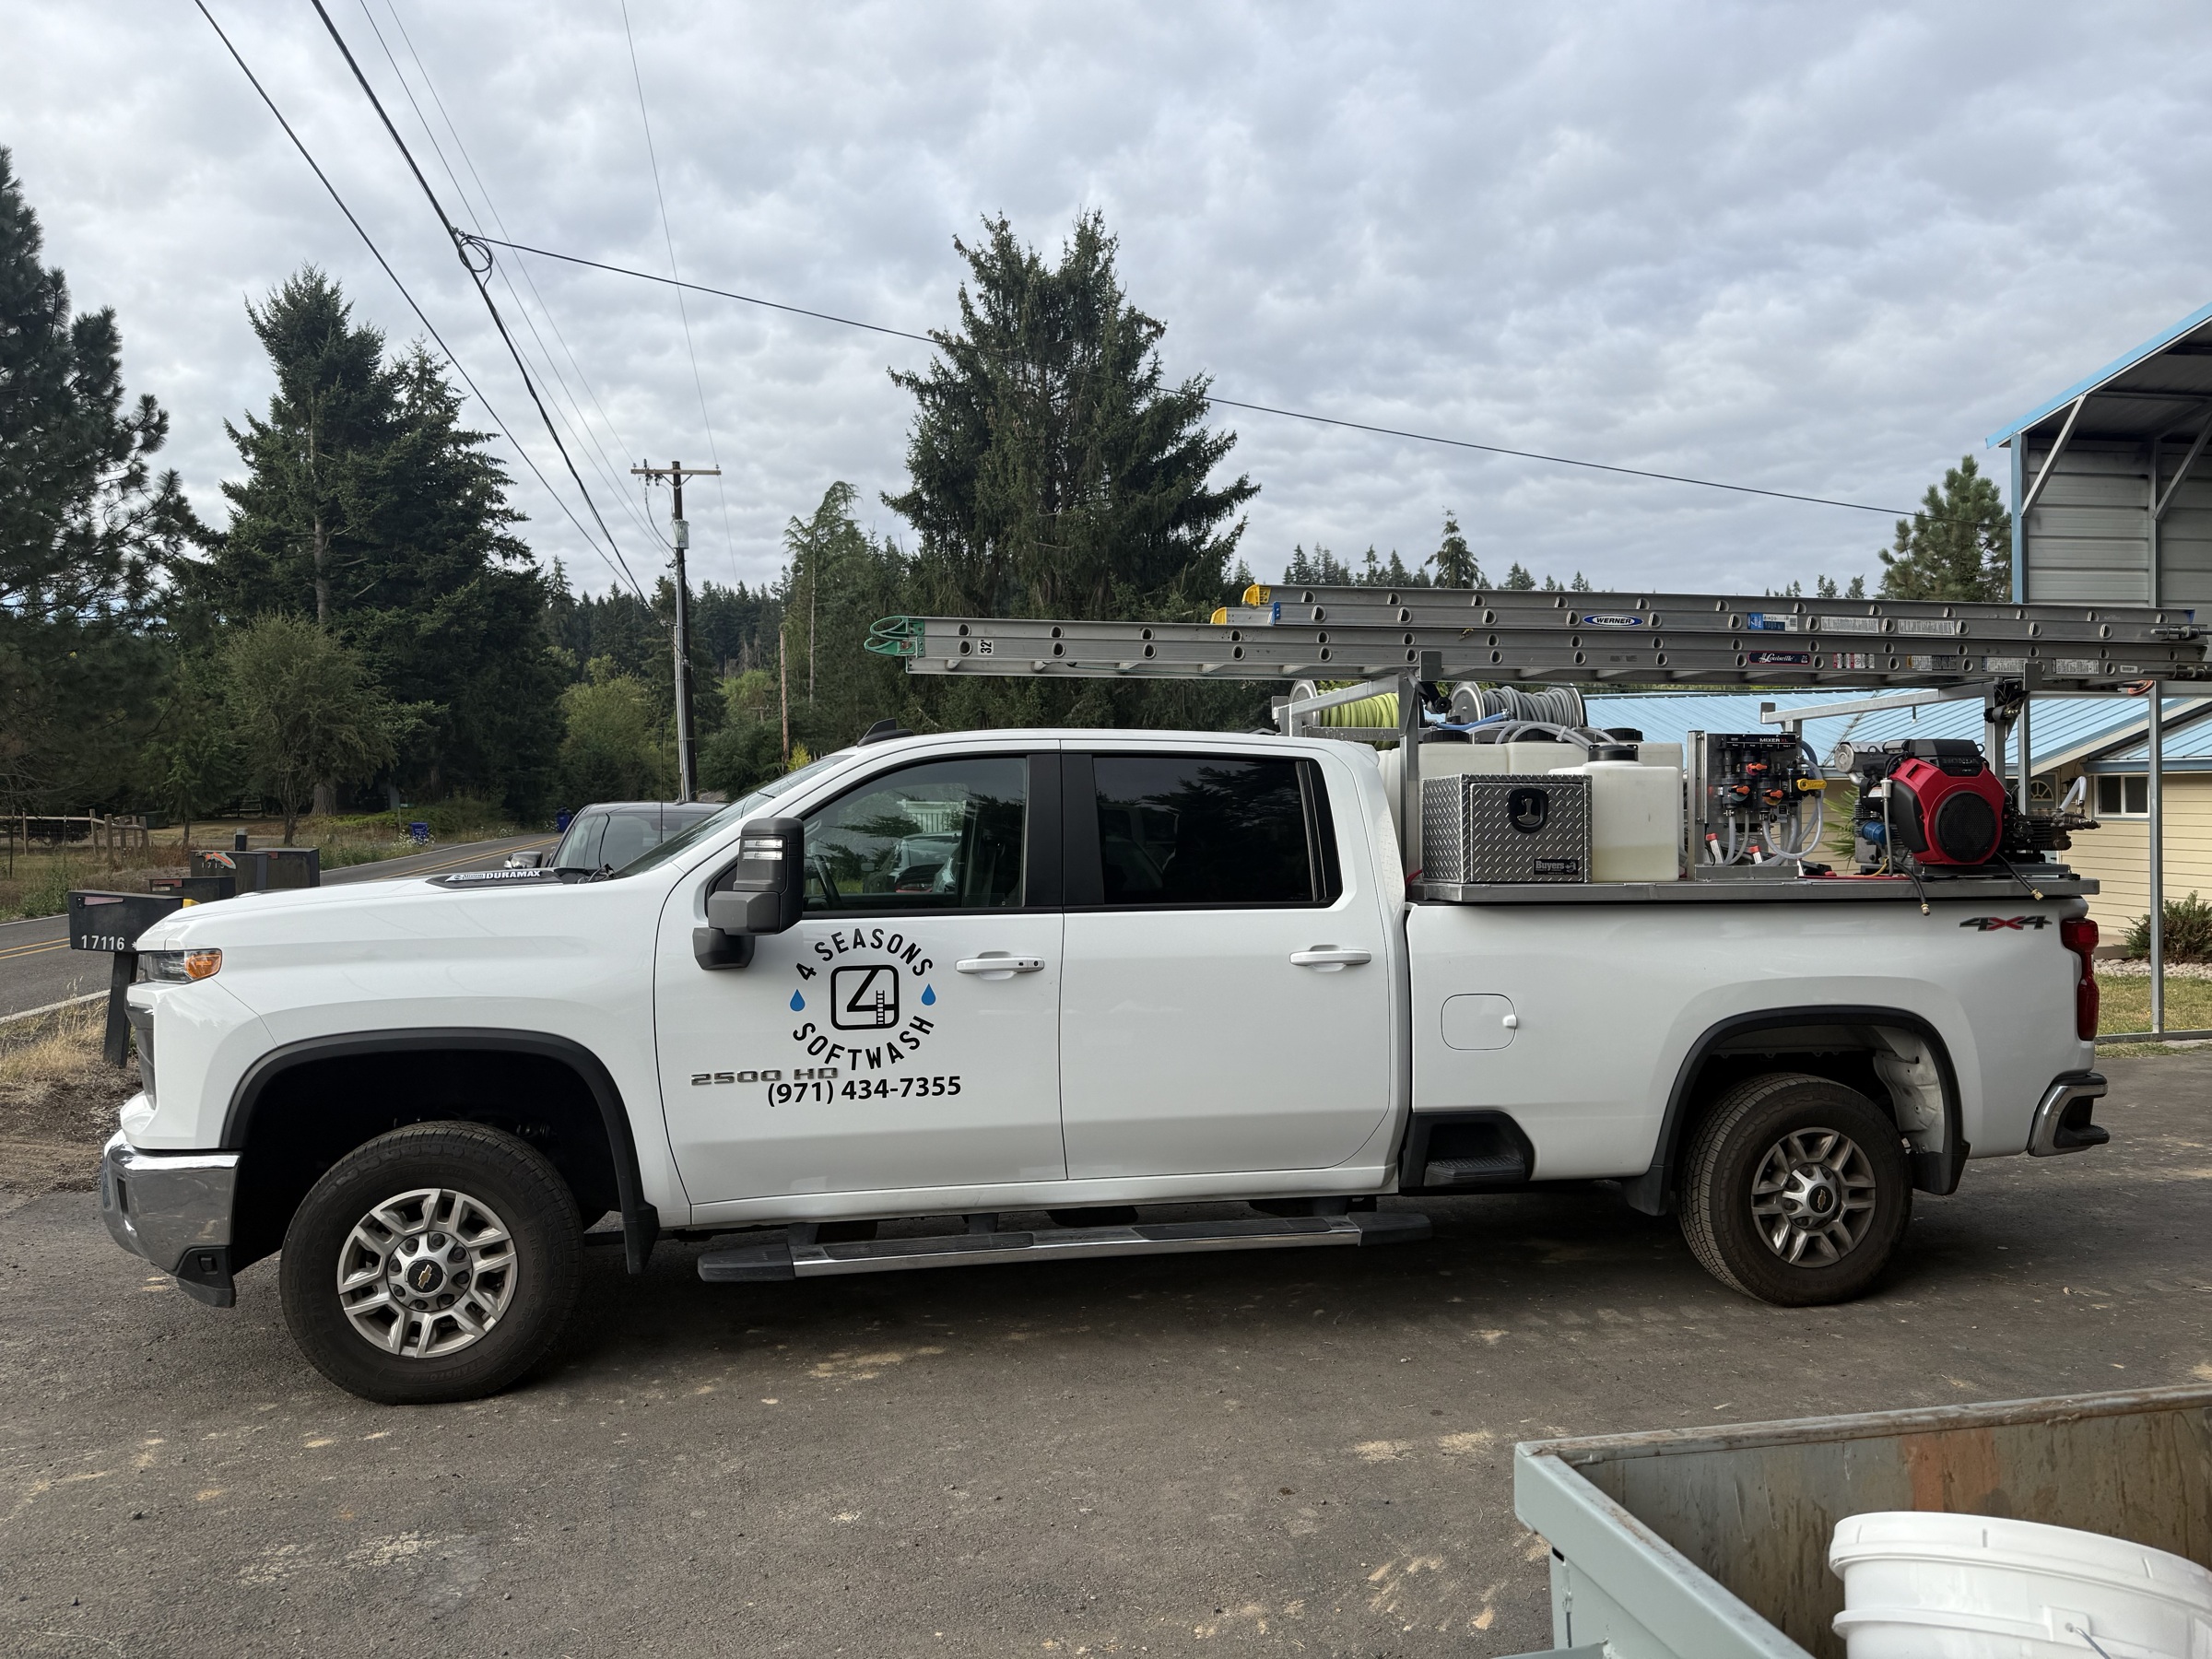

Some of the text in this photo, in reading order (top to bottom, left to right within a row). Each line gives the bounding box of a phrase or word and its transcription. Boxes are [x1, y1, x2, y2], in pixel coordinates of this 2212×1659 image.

[486, 870, 541, 879] DURAMAX
[1535, 860, 1565, 871] Buyers
[81, 935, 125, 951] 17116
[795, 927, 934, 982] 4 SEASONS
[793, 1015, 935, 1071] SOFTWASH
[691, 1067, 838, 1086] 2500 HD
[768, 1076, 961, 1107] (971) 434-7355
